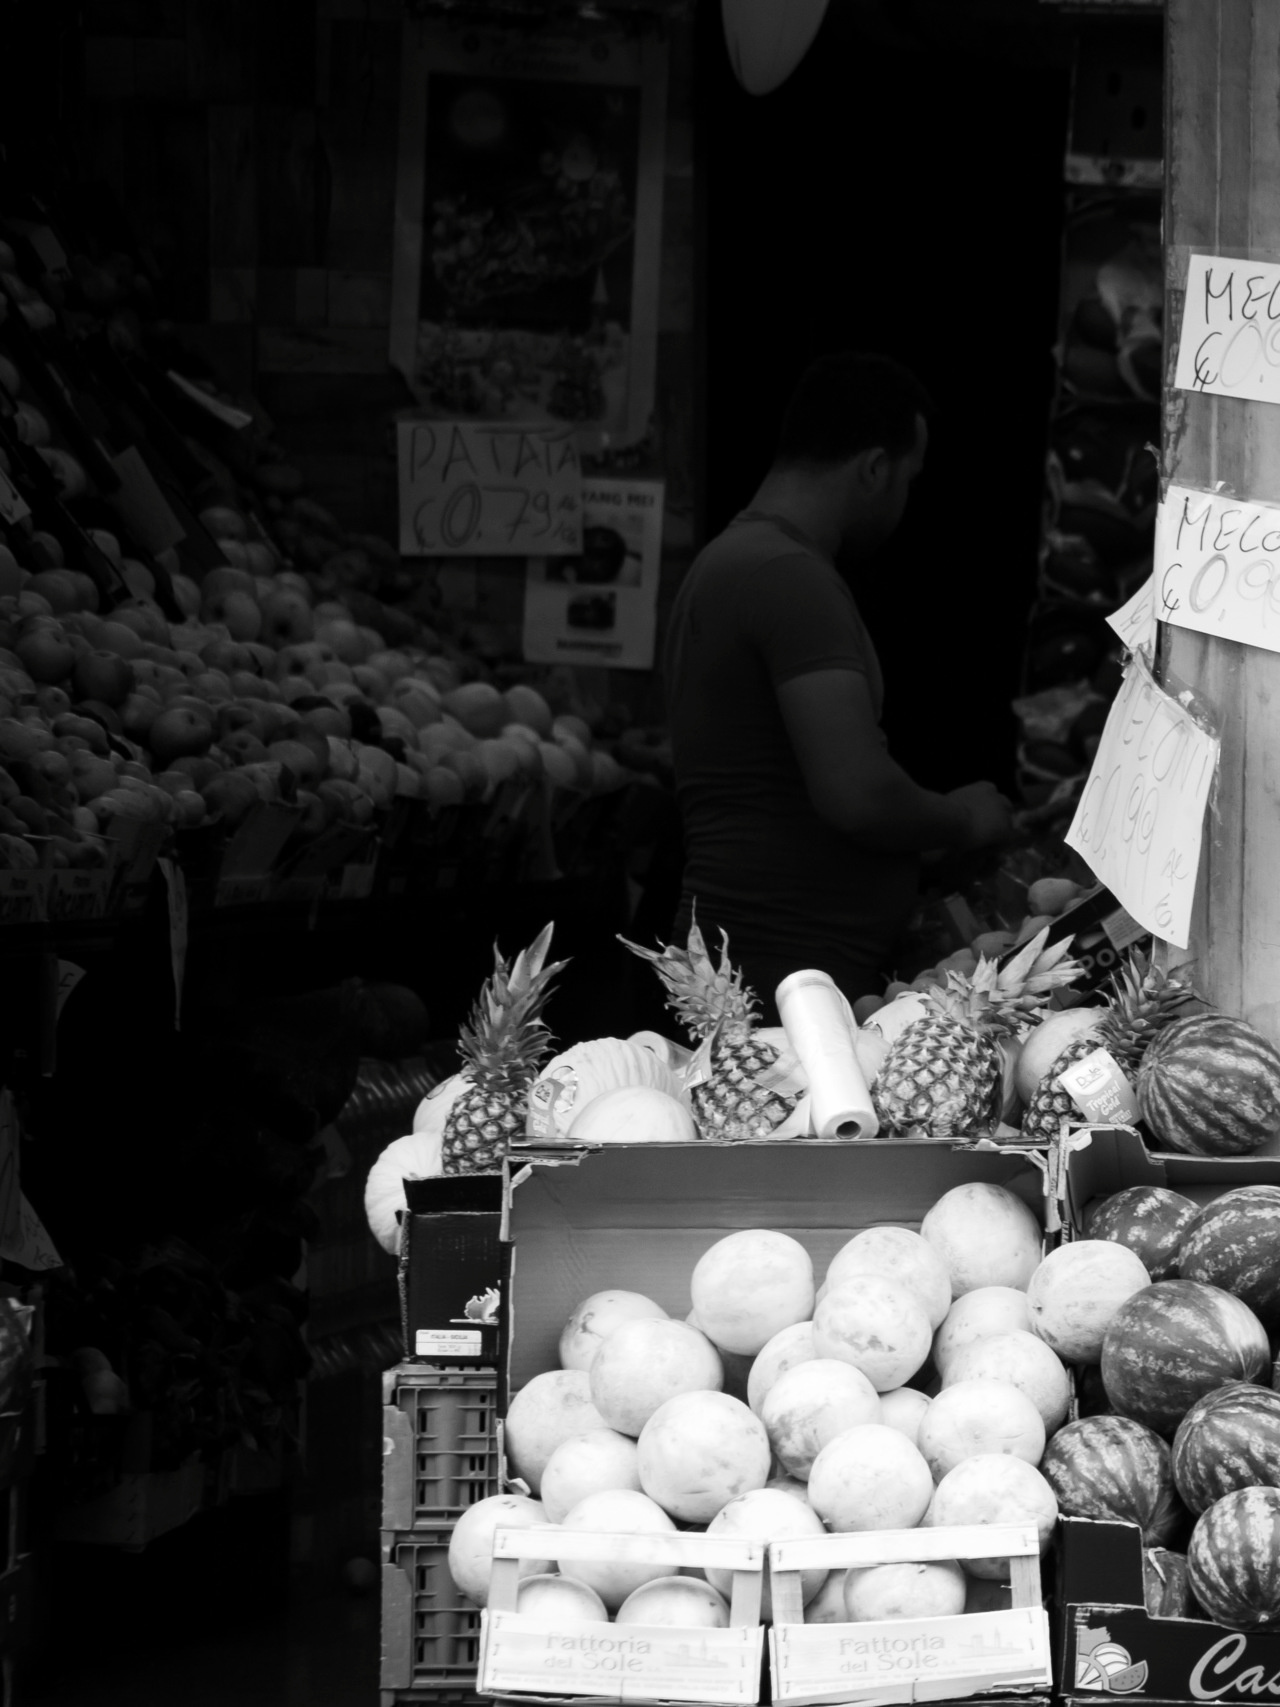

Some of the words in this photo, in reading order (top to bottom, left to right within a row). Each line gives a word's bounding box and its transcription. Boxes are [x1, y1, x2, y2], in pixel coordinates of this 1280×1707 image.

[410, 422, 580, 483] PATATA
[1085, 1079, 1122, 1112] Tropical
[1100, 1096, 1122, 1116] Gold
[545, 1632, 652, 1655] Fattoria
[839, 1633, 946, 1656] Fattoria
[544, 1654, 572, 1669] del
[580, 1651, 643, 1673] Sole
[839, 1660, 868, 1673] del
[877, 1651, 939, 1673] Sole
